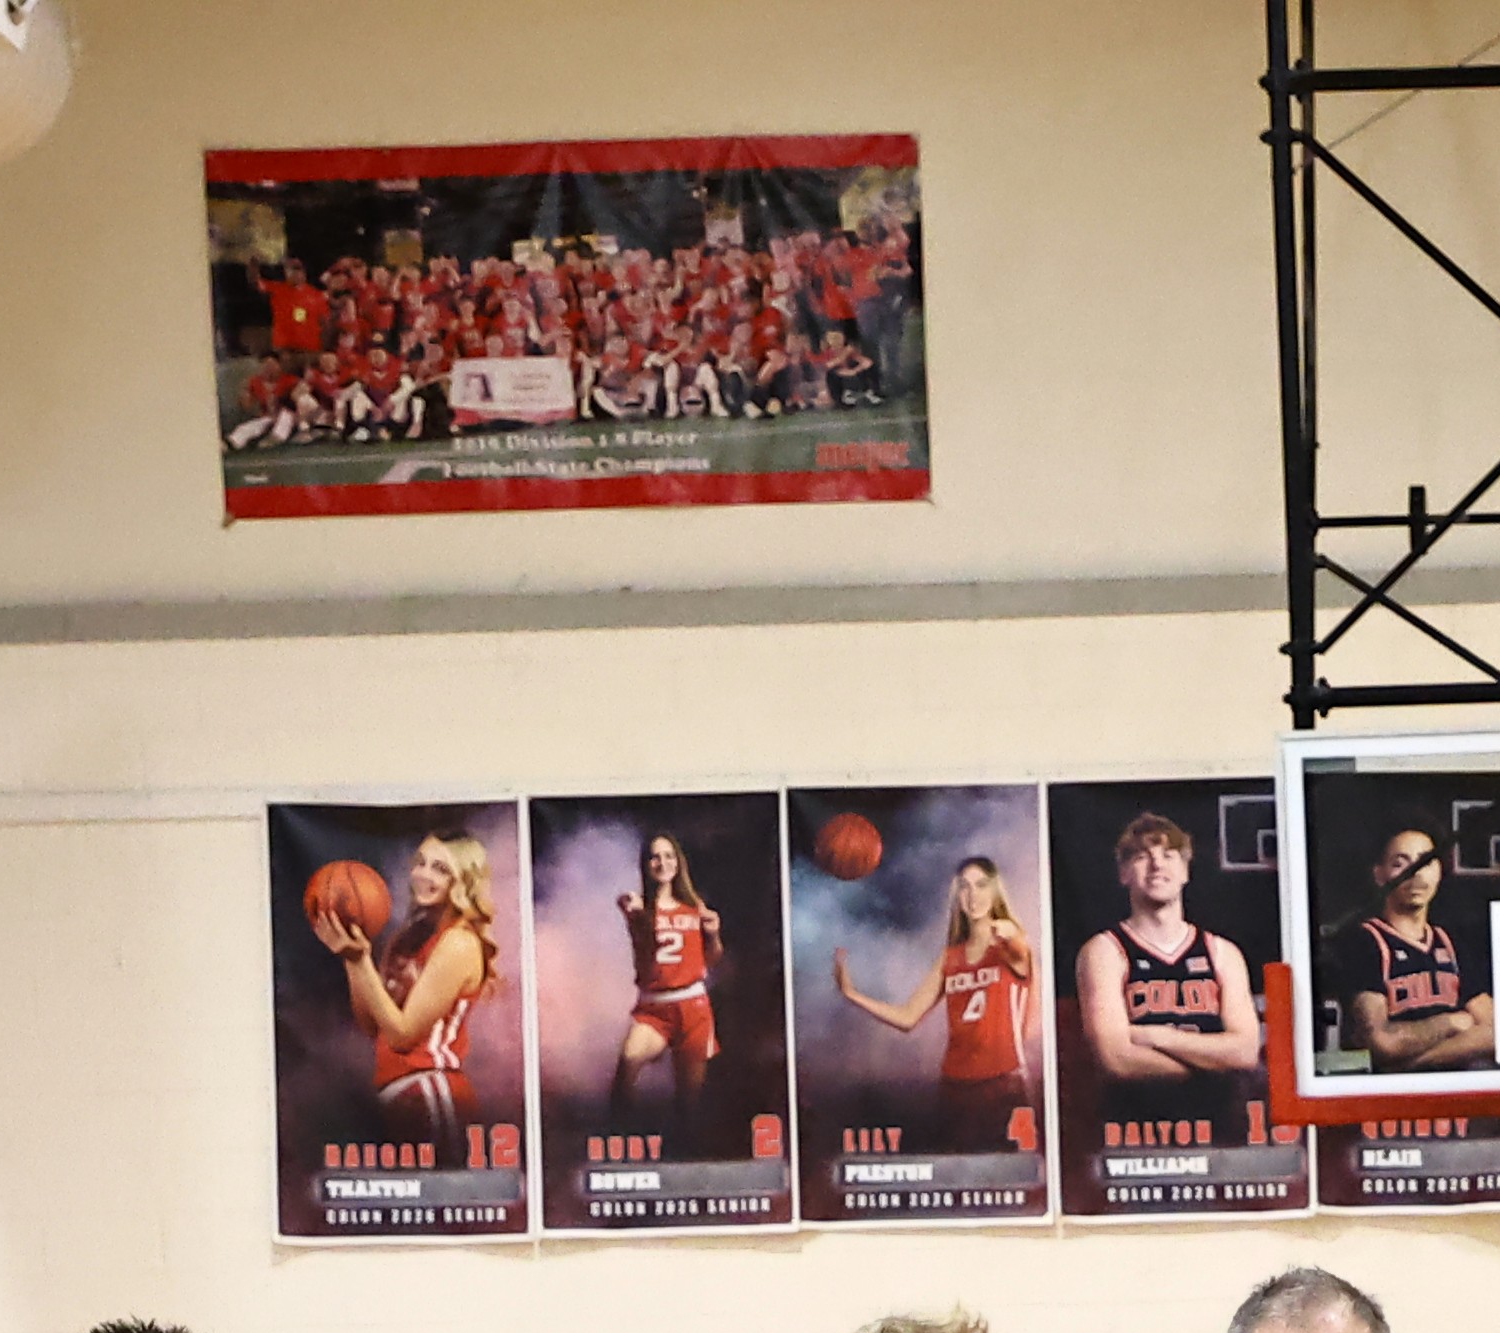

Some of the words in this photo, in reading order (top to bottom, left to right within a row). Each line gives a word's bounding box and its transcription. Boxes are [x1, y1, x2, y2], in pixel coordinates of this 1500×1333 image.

[656, 931, 684, 964] 2
[587, 1135, 663, 1161] RUBY
[751, 1114, 783, 1159] 2
[843, 1127, 902, 1153] LILY
[1007, 1106, 1037, 1151] 4
[1104, 1120, 1212, 1146] DALTON
[466, 1123, 521, 1169] 12
[1106, 1156, 1209, 1177] WILLIAMS
[1362, 1148, 1423, 1167] BLAIR
[1107, 1186, 1163, 1202] COLON
[1224, 1183, 1288, 1200] SENIOR
[1362, 1177, 1419, 1194] COLON
[590, 1202, 647, 1217] COLON
[707, 1198, 771, 1214] SENIOR
[845, 1193, 901, 1209] COLON
[962, 1190, 1026, 1206] SENIOR
[325, 1208, 383, 1225] COLON
[443, 1206, 507, 1223] SENIOR
